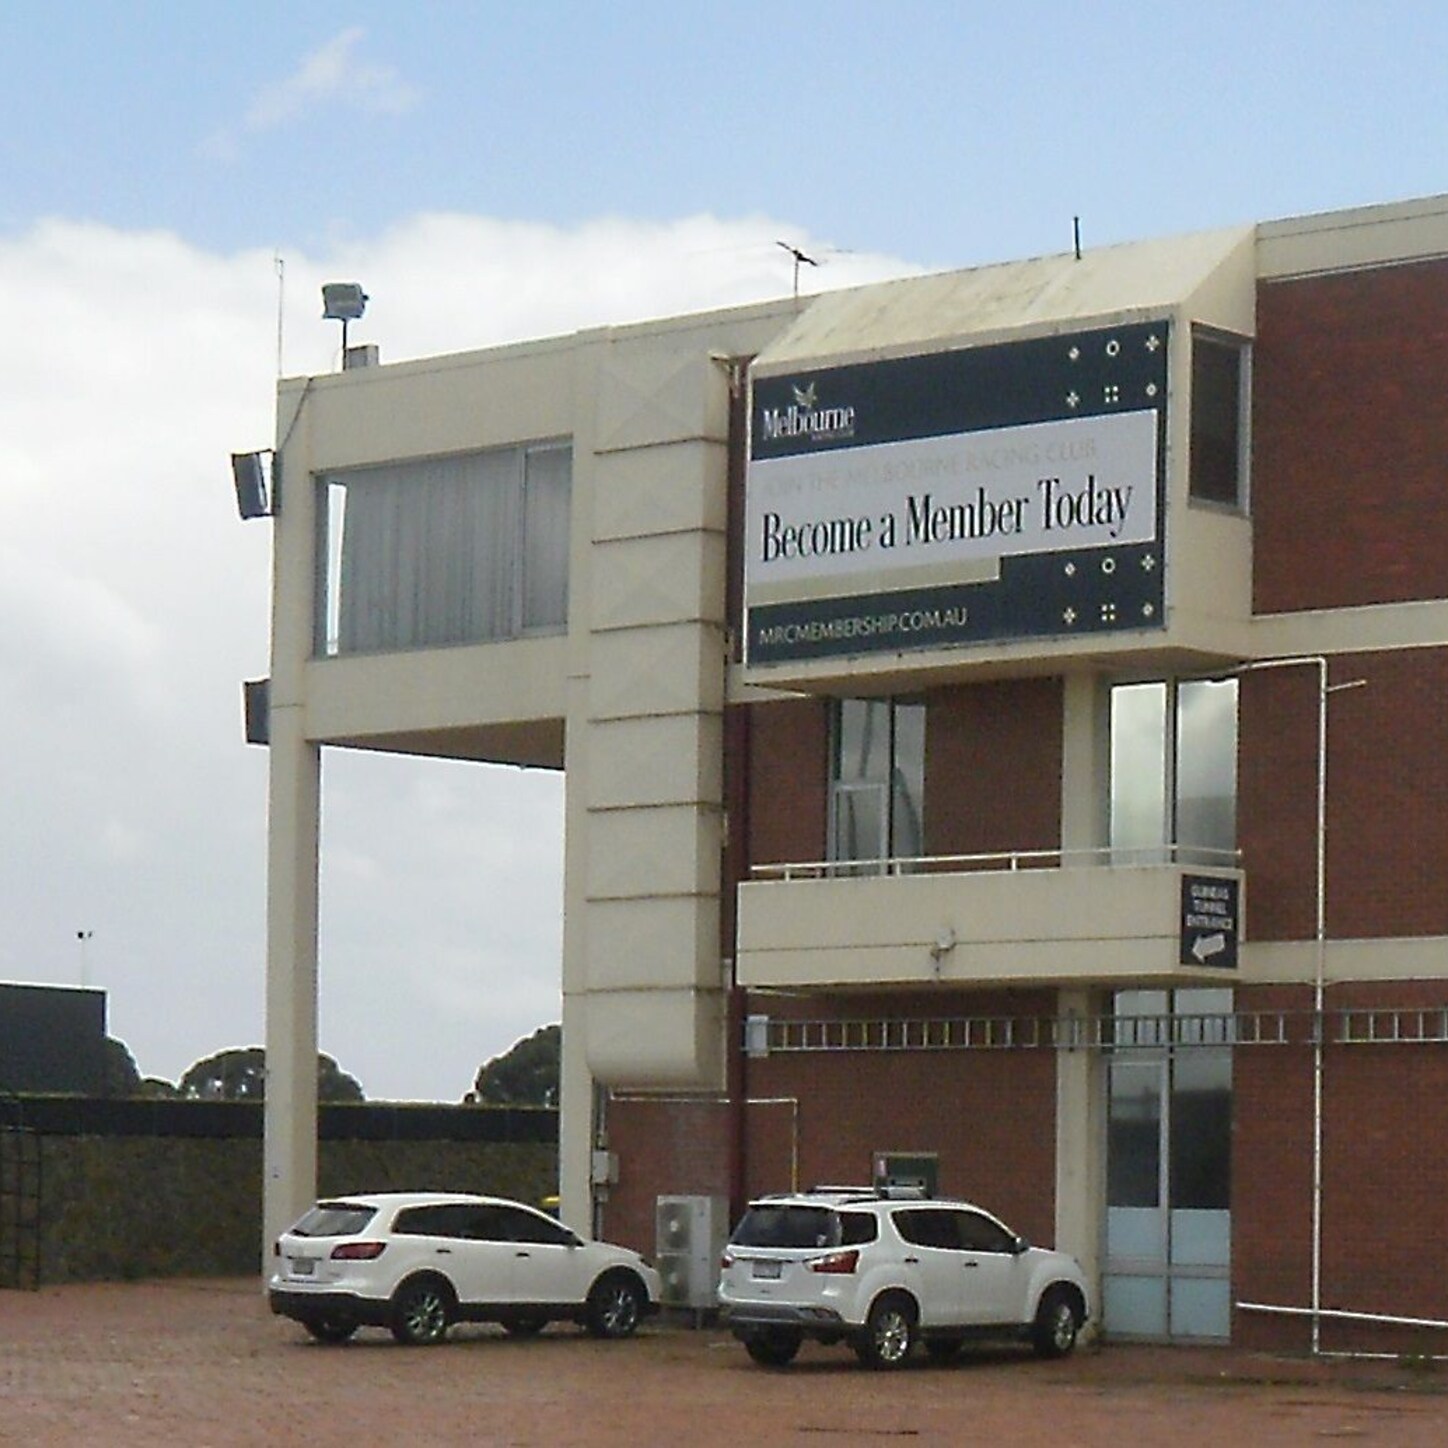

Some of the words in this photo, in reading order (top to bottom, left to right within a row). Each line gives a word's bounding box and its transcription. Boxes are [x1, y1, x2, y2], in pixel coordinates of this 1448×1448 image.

[762, 405, 855, 441] Melbourne
[965, 443, 1040, 473] RACING
[1046, 438, 1097, 463] CLUB
[762, 512, 872, 562] Become
[879, 512, 895, 548] a
[905, 486, 1030, 547] Member
[1037, 475, 1134, 537] Today
[759, 607, 968, 645] MRCMEMBERSHIP.COM.AU
[1186, 914, 1233, 930] ENTRANCE
